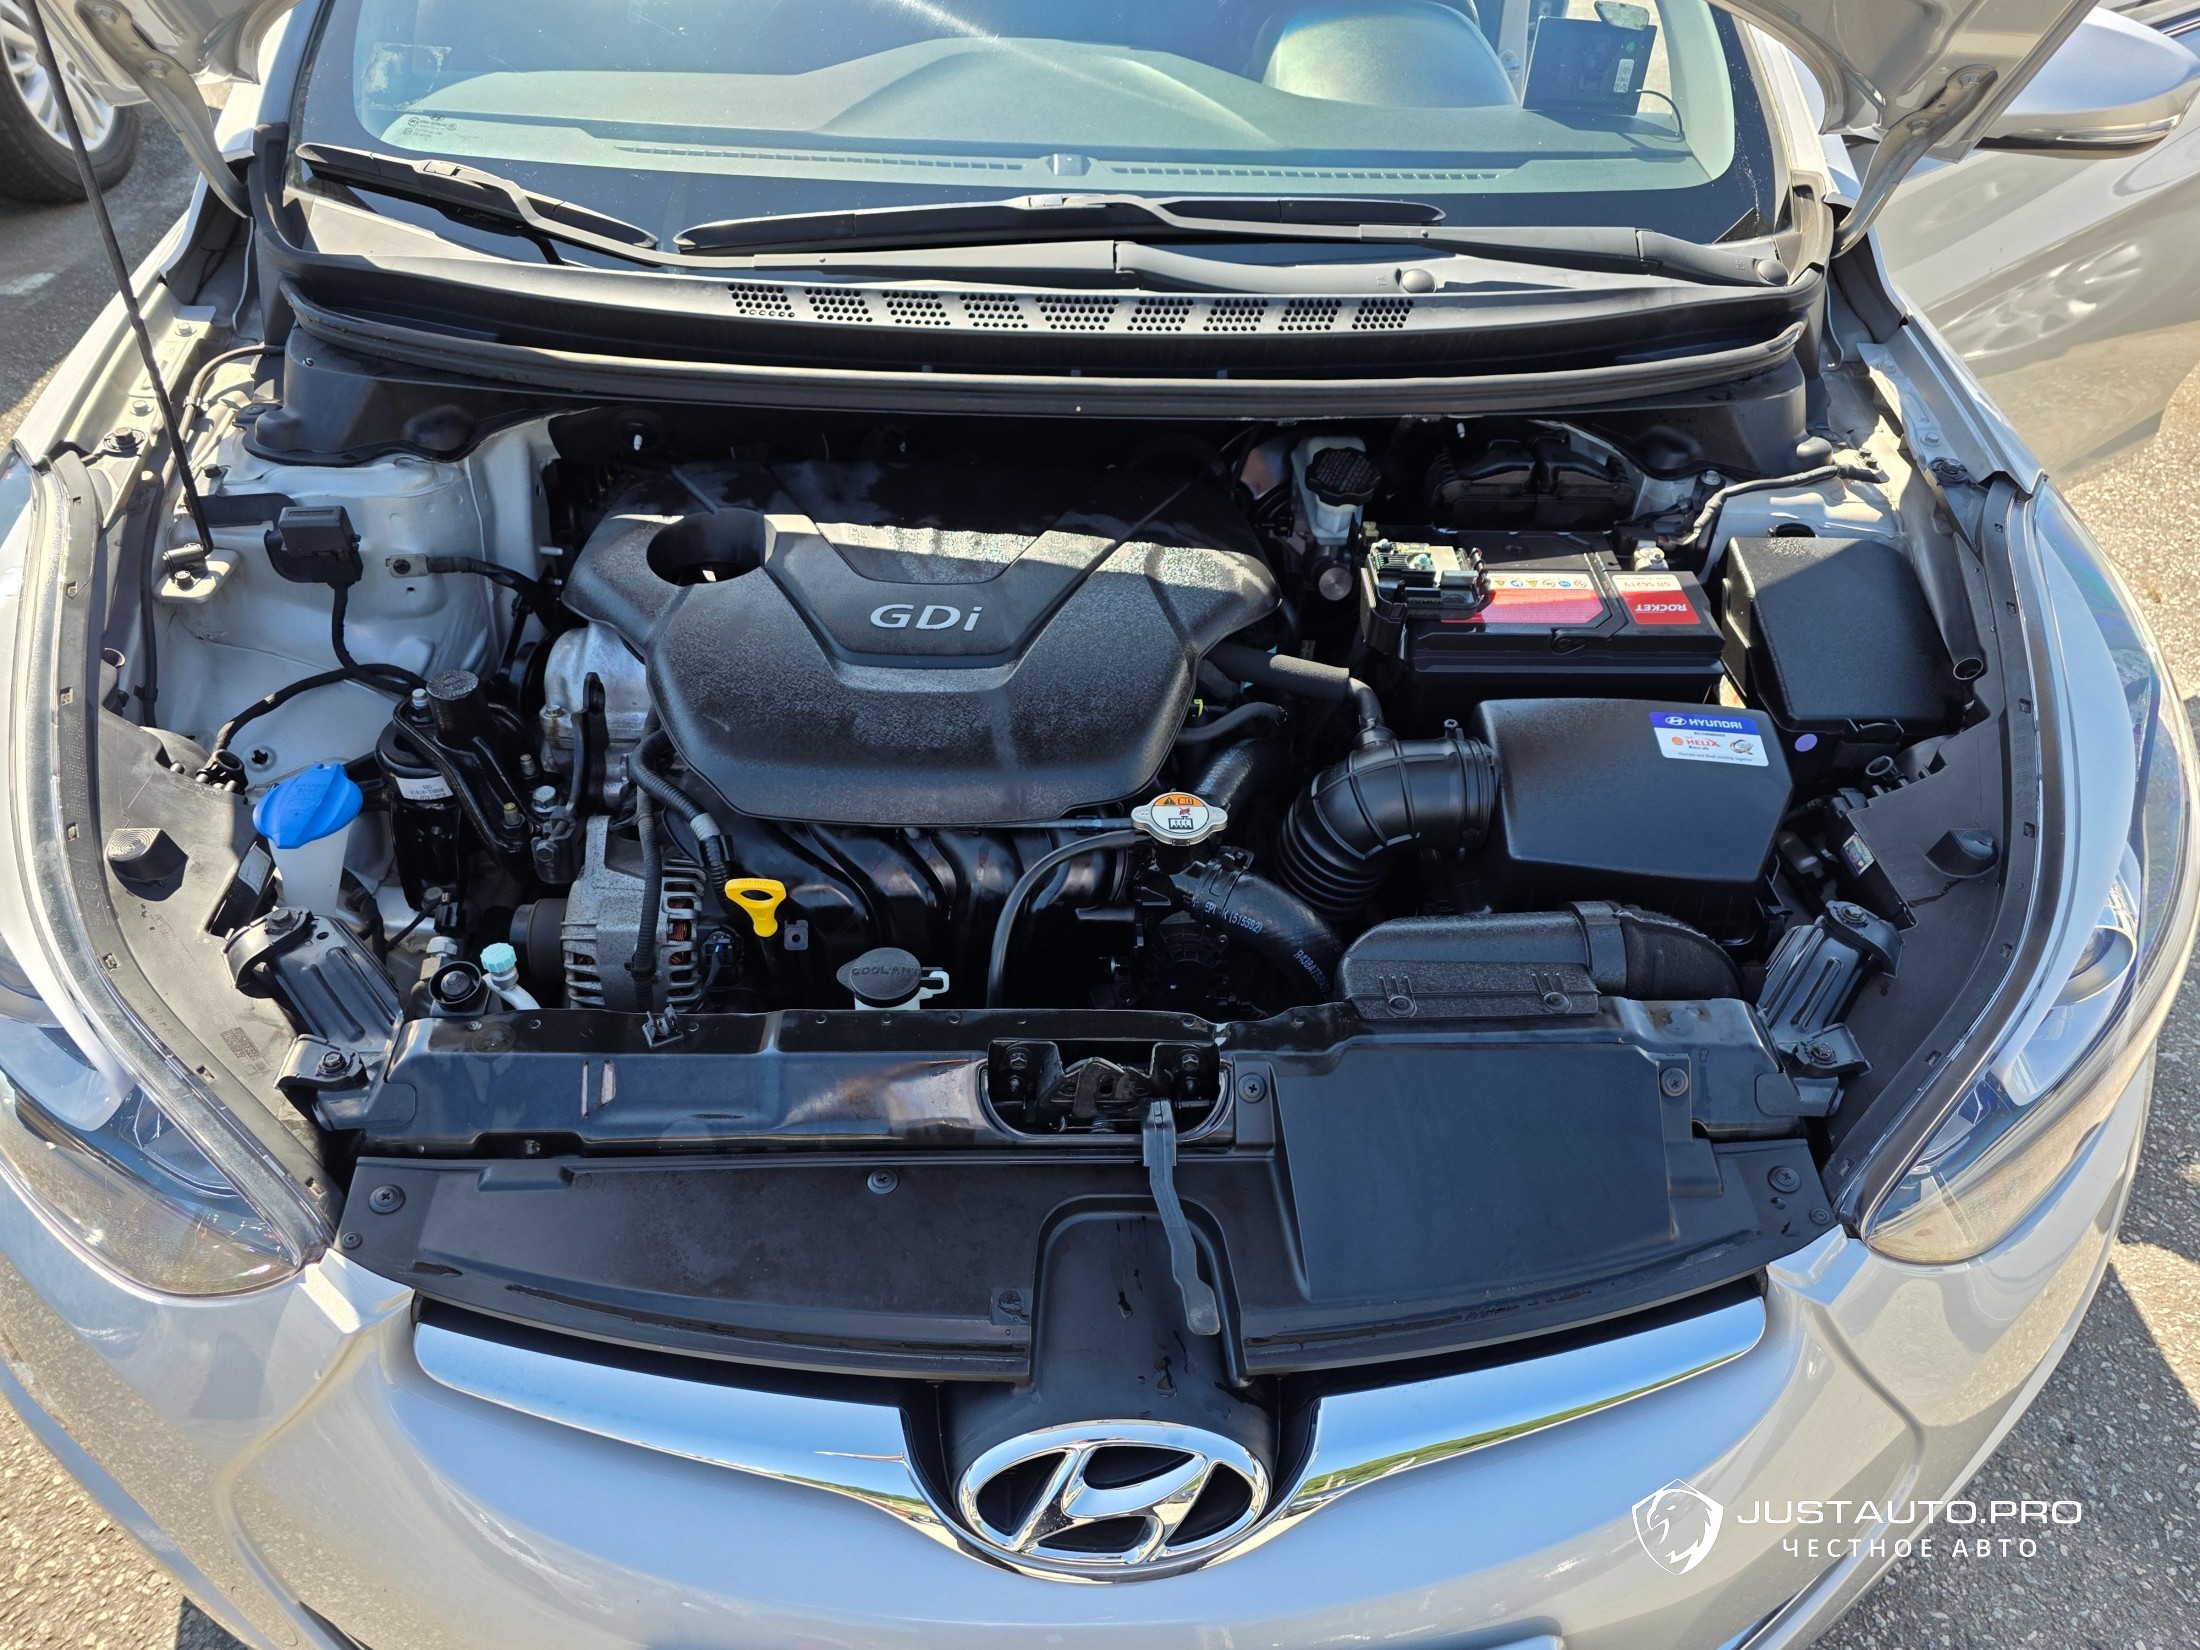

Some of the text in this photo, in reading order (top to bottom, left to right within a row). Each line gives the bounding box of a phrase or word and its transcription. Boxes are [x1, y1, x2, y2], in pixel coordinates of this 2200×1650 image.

[1635, 604, 1688, 612] ROCKET
[870, 604, 983, 631] GDi
[1688, 718, 1743, 730] HYUNDAI
[1686, 738, 1721, 748] HELIX
[1228, 911, 1263, 934] (515592)
[851, 966, 921, 976] COOLANT
